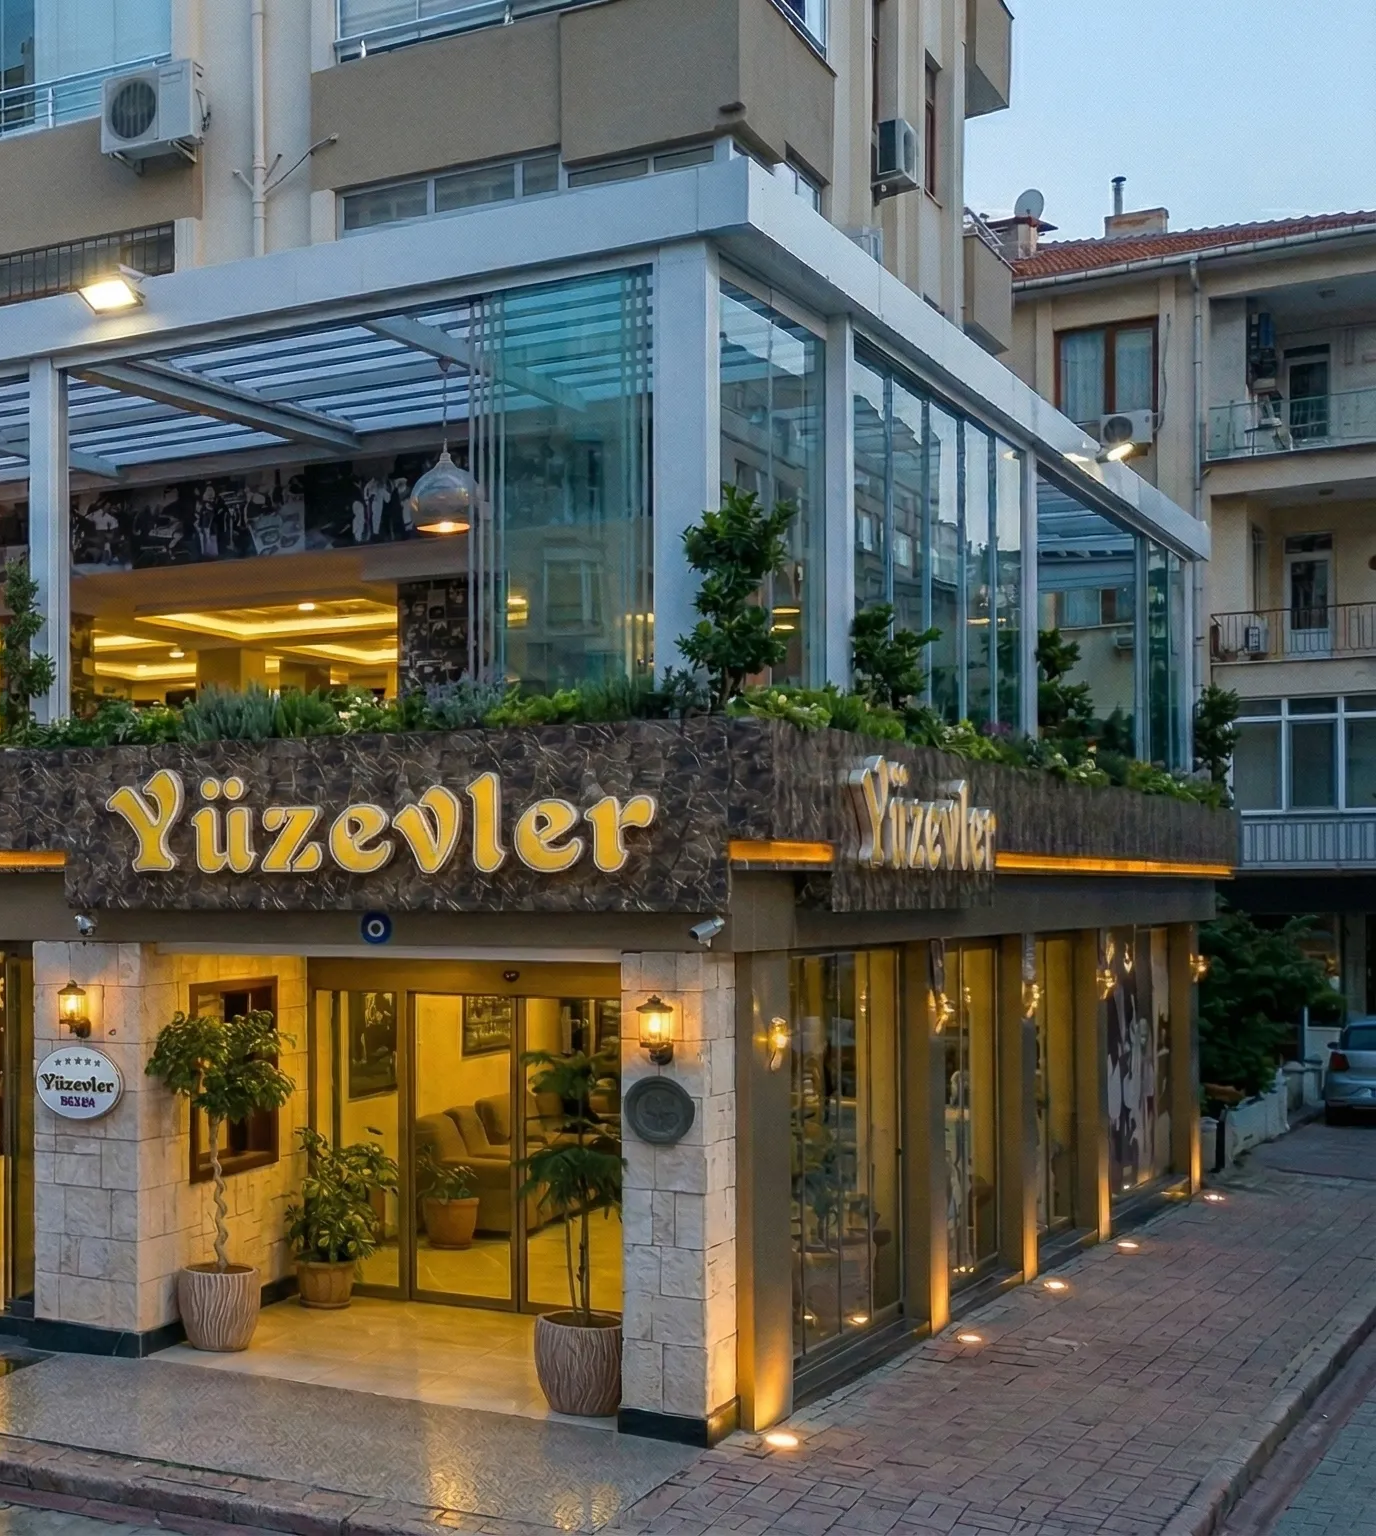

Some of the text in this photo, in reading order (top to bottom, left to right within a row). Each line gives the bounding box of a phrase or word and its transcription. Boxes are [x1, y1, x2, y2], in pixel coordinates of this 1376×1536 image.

[106, 768, 657, 875] Yüzevler
[850, 754, 997, 872] Yüzevler
[40, 1073, 115, 1093] Yüzevler
